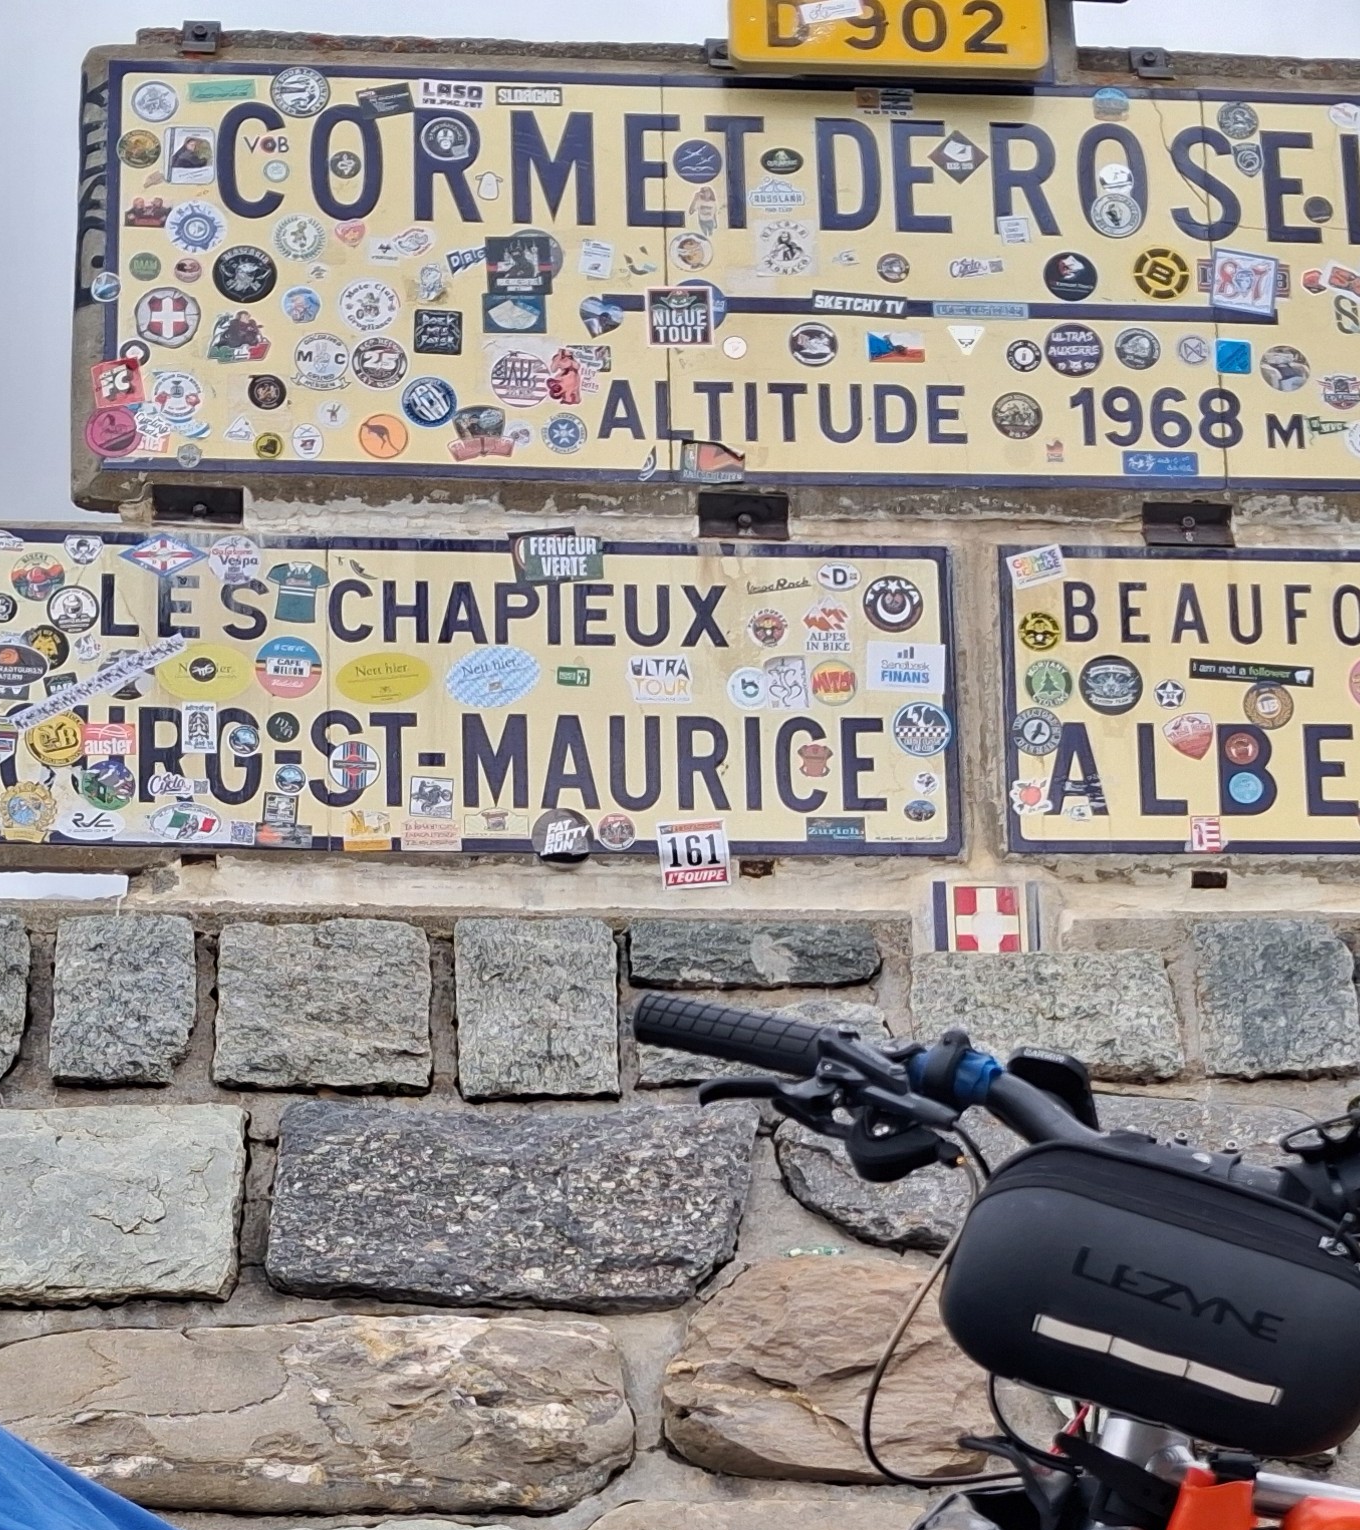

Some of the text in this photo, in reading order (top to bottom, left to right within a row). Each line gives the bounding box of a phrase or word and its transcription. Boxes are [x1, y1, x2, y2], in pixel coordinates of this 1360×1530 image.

[844, 0, 1008, 53] 902
[217, 101, 764, 228] CORMET
[816, 117, 952, 233] DE
[815, 296, 904, 314] SKETCHY TV
[656, 326, 706, 342] TOUT
[1051, 332, 1094, 343] ULTRAS
[298, 351, 346, 365] M C
[598, 379, 1306, 449] ALTITUDE 1968 M
[530, 536, 596, 556] FERVEUR
[219, 557, 257, 568] Vespa
[542, 556, 588, 577] VERTE
[832, 571, 845, 584] D
[100, 573, 728, 648] LES CHAPIEUX
[809, 632, 846, 642] ALPES
[806, 642, 850, 651] IN BIKE
[631, 659, 689, 678] ULTRA
[881, 671, 929, 683] FINANS
[1199, 664, 1216, 673] am
[1219, 665, 1236, 674] not
[1239, 668, 1246, 676] a
[634, 677, 689, 694] TOUR
[84, 739, 132, 754] auster
[546, 826, 591, 843] BETTY
[547, 820, 568, 834] FAT
[545, 838, 575, 856] RUN
[668, 834, 721, 868] 161
[1072, 1246, 1285, 1343] LEZYNE
